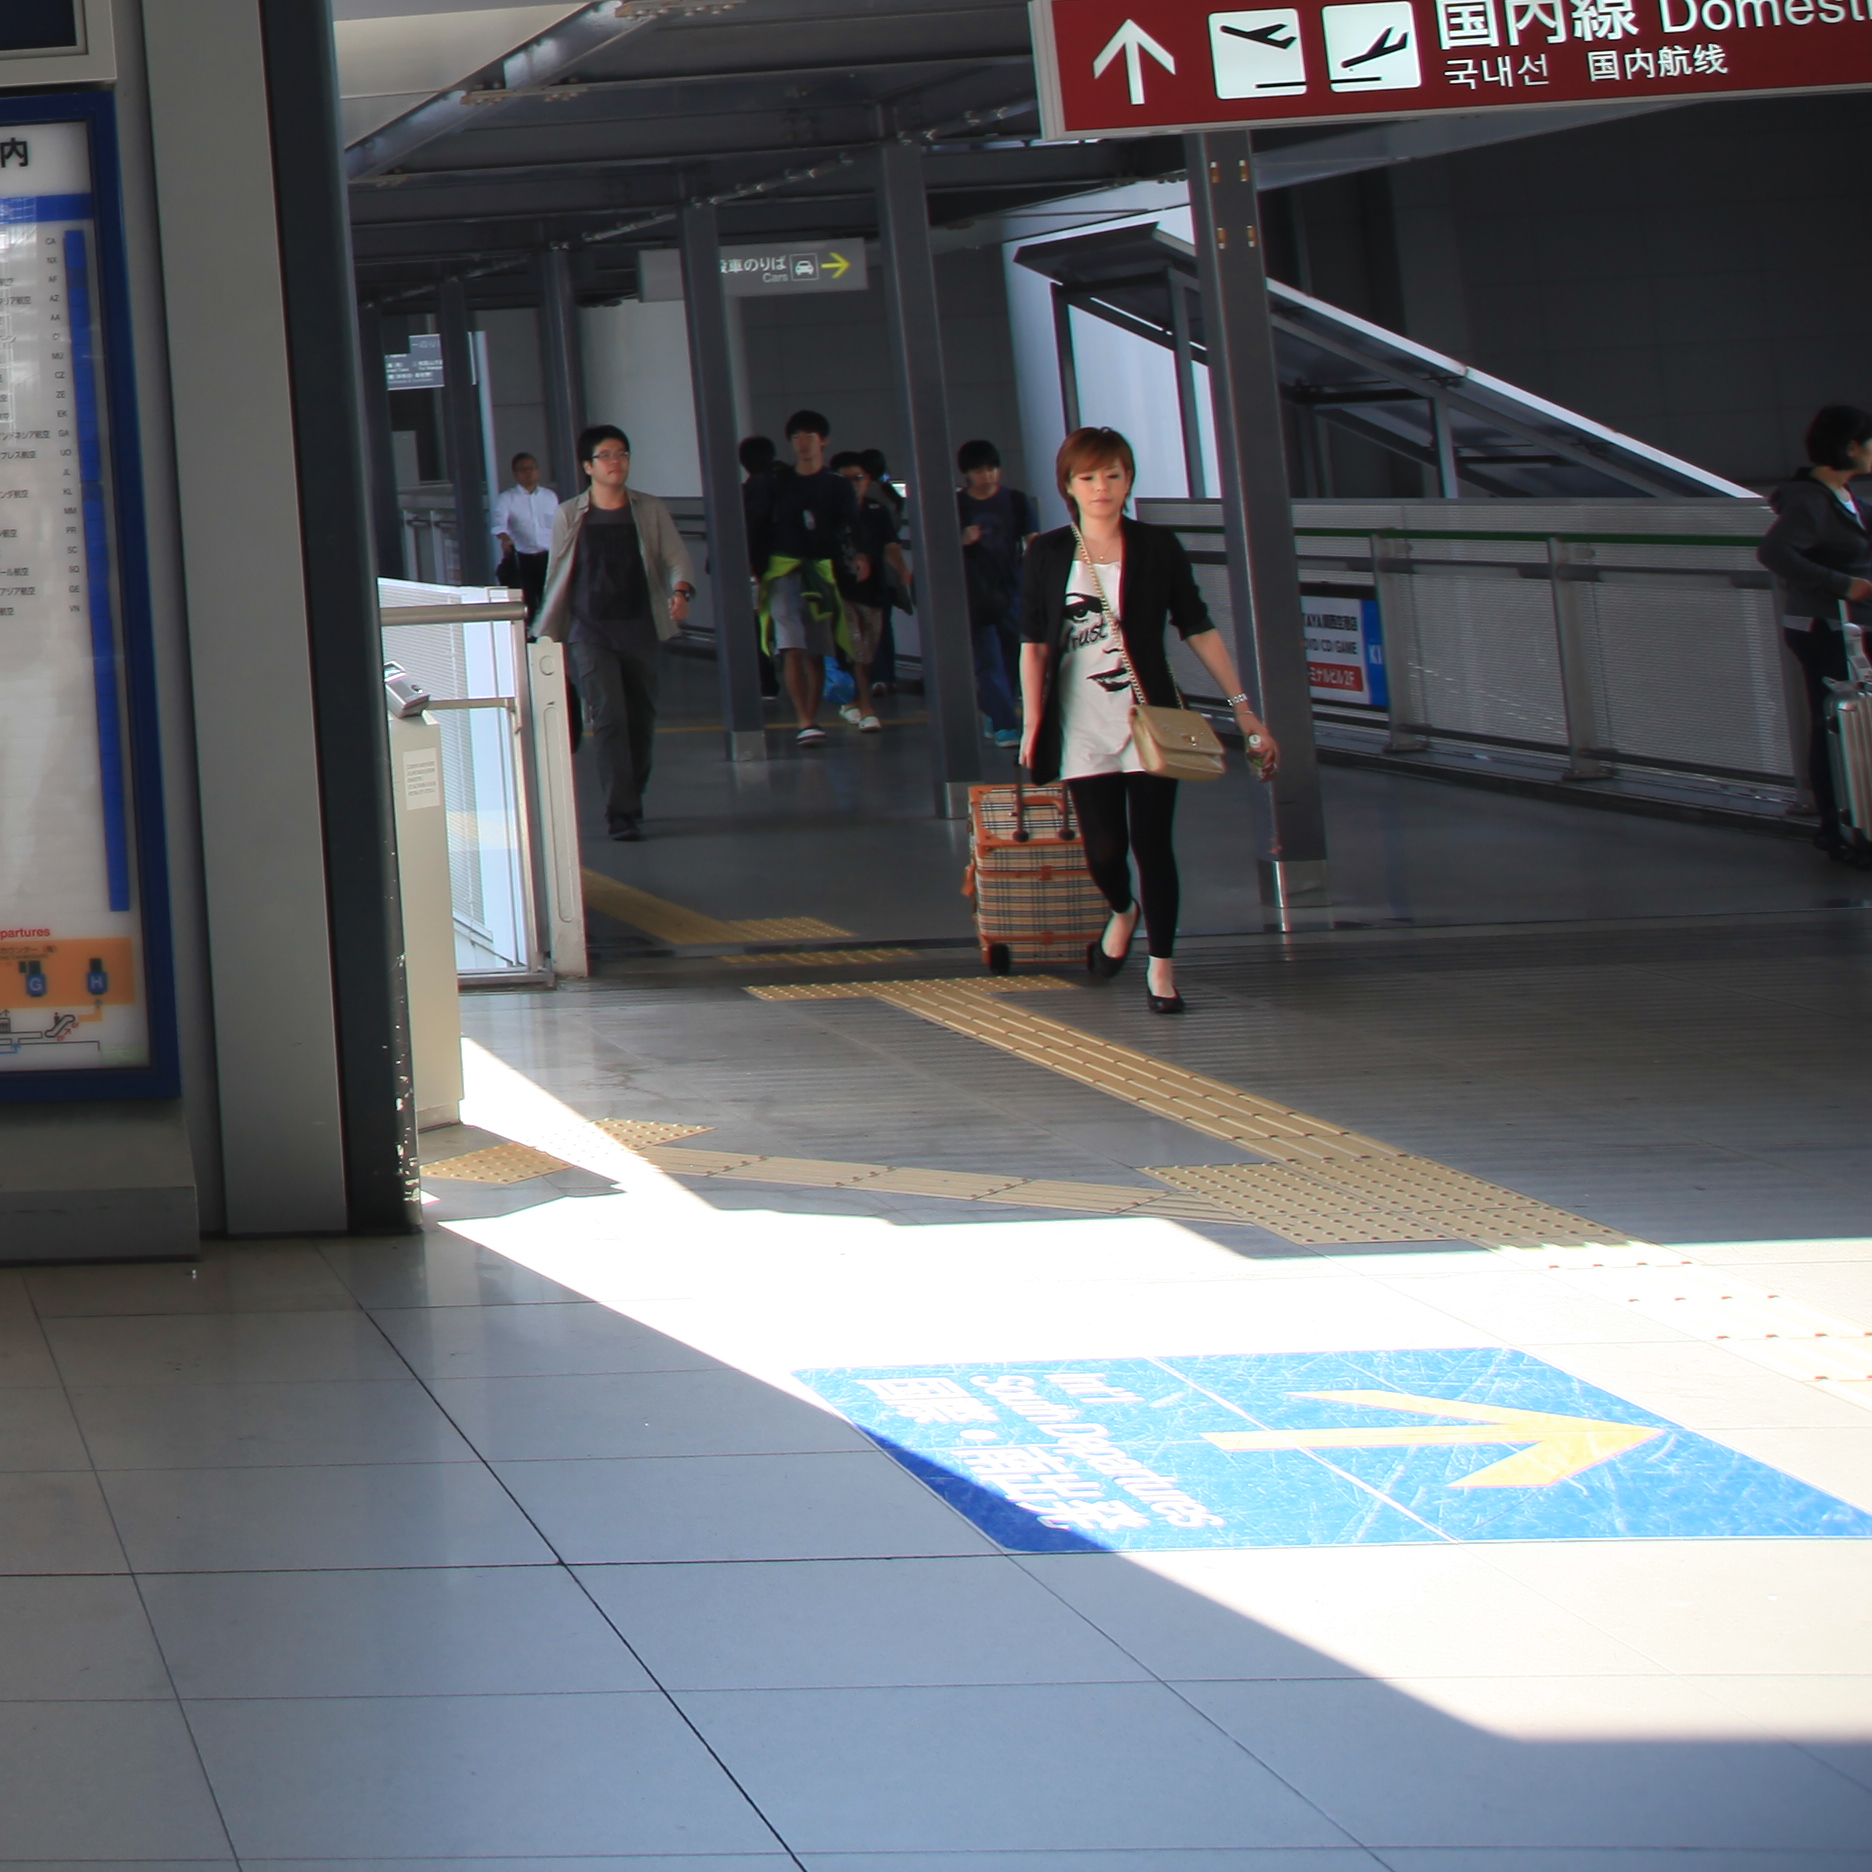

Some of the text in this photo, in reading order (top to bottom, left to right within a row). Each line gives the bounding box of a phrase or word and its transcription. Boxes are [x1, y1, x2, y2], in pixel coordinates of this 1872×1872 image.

[1445, 43, 1729, 90] 국내선 国内航线
[762, 272, 789, 283] Cars
